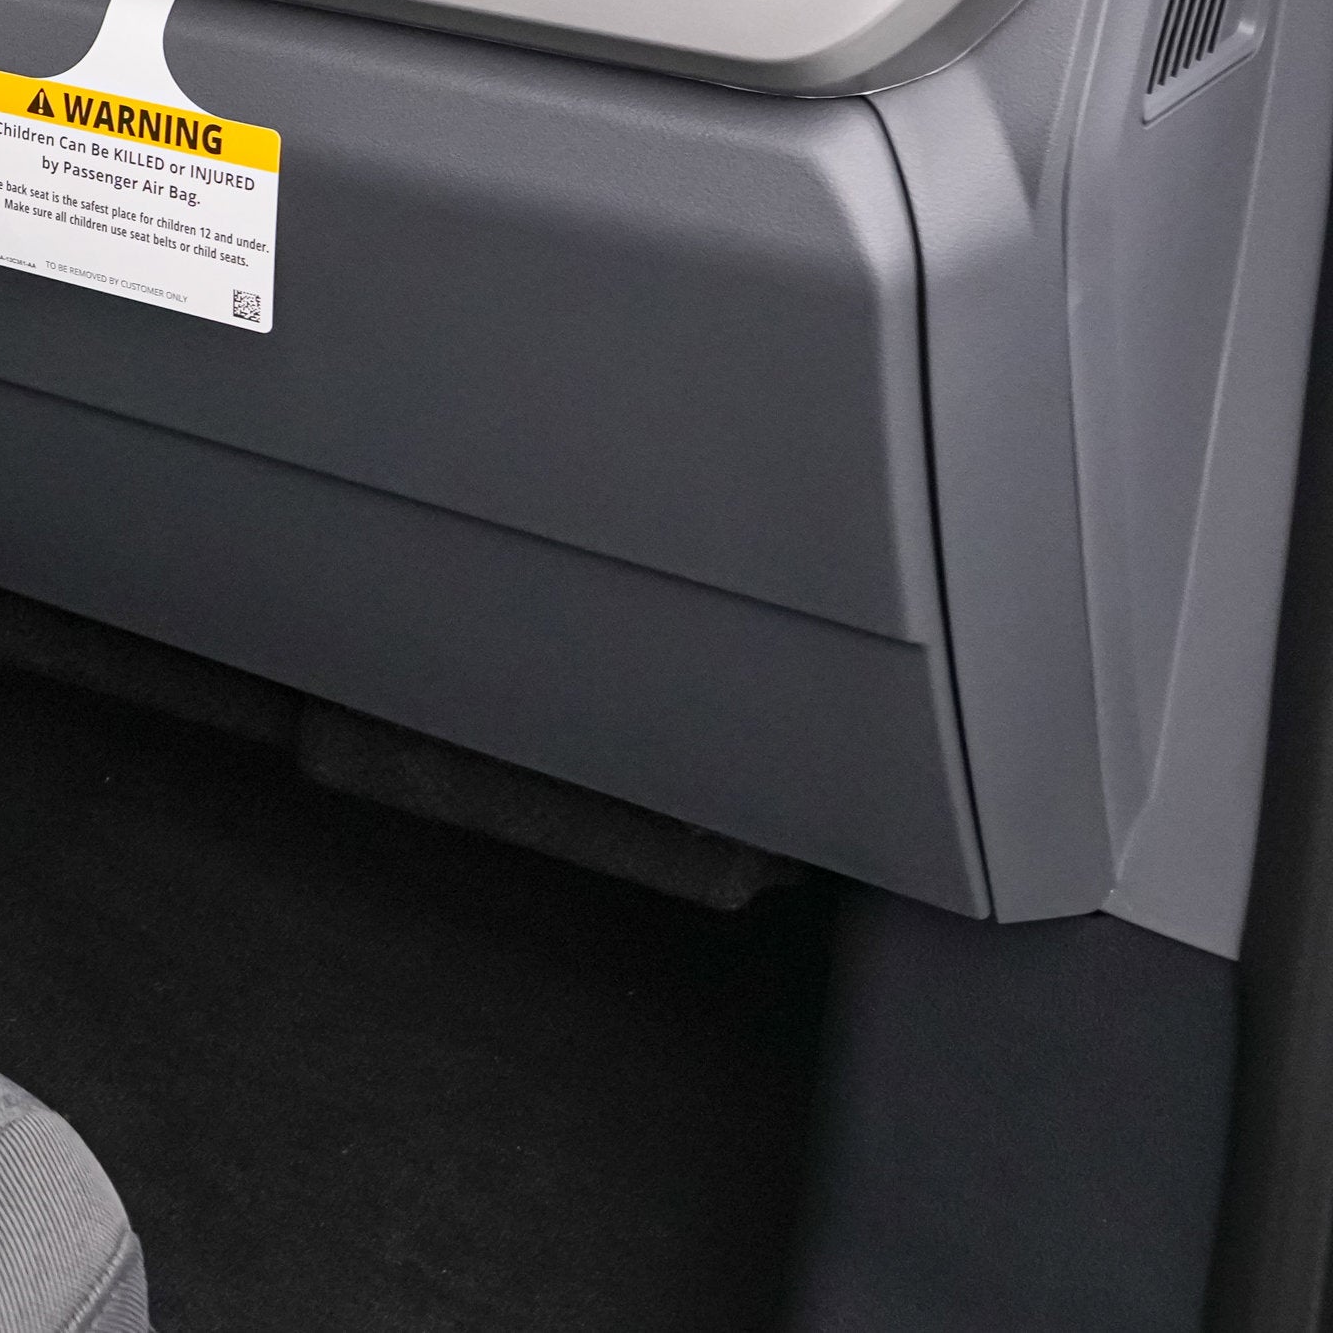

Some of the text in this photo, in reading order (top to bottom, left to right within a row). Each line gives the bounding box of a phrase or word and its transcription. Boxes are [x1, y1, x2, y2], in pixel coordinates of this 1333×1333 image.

[63, 92, 223, 155] WARNING
[42, 155, 201, 207] by Passenger Air Bag.
[59, 136, 86, 154] Can
[91, 142, 109, 159] Be
[114, 147, 165, 171] KILLED
[169, 163, 186, 176] or
[190, 164, 255, 191] INJURED
[4, 198, 249, 267] Make sure all children use seat belts or child seats.
[6, 180, 28, 196] back
[29, 188, 50, 201] seat
[52, 191, 60, 203] is
[62, 194, 78, 208] the
[80, 200, 109, 215] safest
[111, 206, 137, 222] place
[139, 211, 154, 226] for
[156, 217, 196, 236] children
[199, 227, 211, 240] 12
[213, 232, 233, 245] and
[236, 237, 269, 253] under.
[45, 260, 188, 303] TO BE REMOVED BY CUSTOMER ONLY
